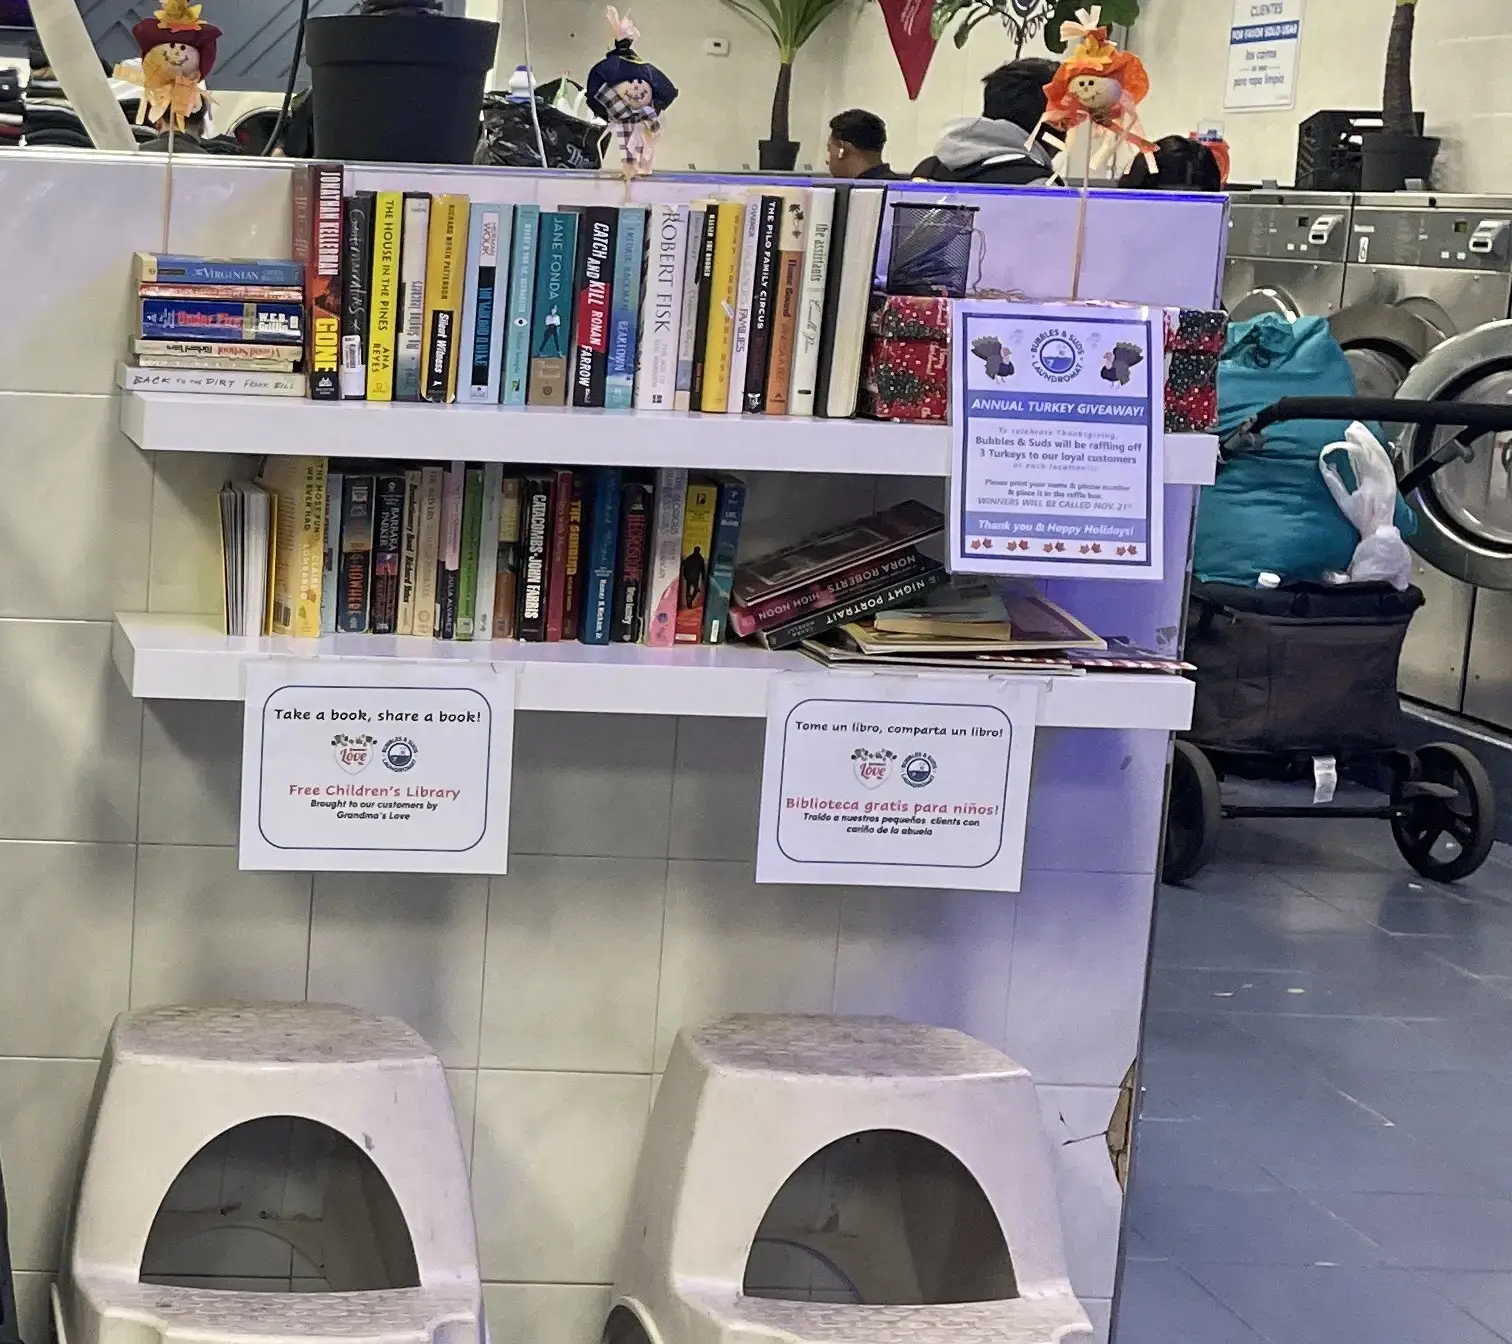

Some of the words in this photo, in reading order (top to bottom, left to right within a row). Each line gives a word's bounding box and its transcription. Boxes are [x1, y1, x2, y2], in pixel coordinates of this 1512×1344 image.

[319, 171, 341, 220] JONATHAN
[384, 200, 395, 219] THE
[767, 201, 777, 222] THE
[381, 222, 394, 262] HOUSE
[482, 222, 491, 256] WOUK
[551, 217, 564, 250] JANE
[591, 222, 610, 259] CATCH
[764, 224, 774, 249] PILO
[814, 223, 829, 238] the
[318, 221, 340, 276] KELLERMAN
[659, 212, 679, 287] ROBERT
[381, 264, 391, 276] IN
[586, 257, 602, 279] AND
[760, 250, 772, 288] FAMILY
[809, 239, 828, 283] assistants
[200, 267, 259, 280] VIRGINIAN
[548, 253, 563, 300] FONDA
[380, 278, 390, 298] THE
[587, 280, 606, 306] KILL
[377, 300, 390, 331] PINES
[654, 293, 673, 333] FISK
[757, 290, 768, 330] CIRCUS
[437, 312, 450, 340] Silent
[589, 310, 604, 346] RONAN
[735, 307, 749, 353] FAMILIES
[315, 317, 338, 373] GONE
[1030, 329, 1060, 354] BUBBLES
[1061, 329, 1067, 338] &
[1068, 333, 1086, 356] SUDS
[371, 343, 381, 373] REYES
[381, 346, 390, 370] ANA
[434, 340, 448, 374] Witness
[578, 344, 593, 387] FARROW
[133, 375, 171, 386] BACK
[205, 377, 236, 389] DIRT
[273, 381, 296, 390] BILL
[1031, 360, 1084, 384] LAUNDROMAT
[971, 398, 1025, 412] ANNUAL
[1027, 400, 1076, 414] TURKEY
[1077, 403, 1145, 417] GIVEAWAY!
[975, 436, 1015, 446] Bubbles
[1017, 437, 1026, 446] &
[1028, 437, 1052, 448] Suds
[1054, 439, 1072, 449] will
[1074, 440, 1086, 449] be
[1088, 441, 1125, 453] raffling
[1127, 443, 1142, 452] off
[979, 448, 986, 457] 3
[989, 449, 1027, 461] Turkeys
[1028, 451, 1039, 460] to
[1041, 452, 1059, 461] our
[1061, 452, 1085, 464] loyal
[1087, 455, 1137, 465] customers
[305, 484, 313, 508] EVER
[314, 484, 323, 512] MOST
[977, 497, 1020, 507] WINNERS
[1022, 499, 1043, 507] WILL
[1058, 500, 1092, 509] CALLED
[303, 510, 312, 531] HAD
[313, 514, 322, 533] FUN
[379, 511, 390, 547] PARKER
[388, 507, 401, 551] BARBARA
[530, 494, 547, 554] CATACOMBS
[978, 519, 1011, 531] Thank
[1012, 522, 1033, 532] you
[1035, 523, 1045, 532] &
[1047, 523, 1082, 536] Happy
[1083, 524, 1135, 537] Holidays!
[526, 556, 543, 583] JOHN
[881, 554, 916, 574] NORA
[346, 563, 365, 616] NOWHERE
[446, 573, 456, 597] JULIA
[826, 568, 880, 593] ROBERTS
[887, 581, 926, 602] NIGHT
[524, 584, 541, 619] FARRIS
[758, 601, 792, 621] NOON
[792, 591, 821, 607] HIGH
[824, 596, 885, 625] PORTRAIT
[444, 598, 454, 634] ALVAREZ
[274, 708, 311, 721] Take
[315, 712, 325, 721] a
[330, 709, 372, 723] book,
[377, 710, 419, 723] share
[423, 712, 434, 723] a
[439, 710, 482, 723] book!
[795, 721, 829, 732] Tome
[832, 724, 848, 732] un
[852, 721, 884, 734] libro,
[887, 724, 947, 737] comparta
[951, 727, 967, 737] un
[971, 727, 1004, 738] libro!
[339, 748, 368, 766] Love
[859, 762, 886, 780] Love
[289, 784, 321, 797] Free
[325, 784, 402, 798] Children's
[405, 786, 461, 801] Library
[310, 799, 347, 809] Brought
[348, 800, 358, 808] to
[377, 801, 424, 810] customers
[426, 801, 439, 812] by
[336, 810, 387, 820] Grandma's
[389, 811, 411, 820] Love
[785, 797, 859, 811] Biblioteca
[864, 799, 909, 814] gratis
[913, 802, 948, 816] para
[953, 802, 1000, 816] niños!
[833, 814, 840, 822] a
[841, 814, 880, 824] nuestros
[881, 815, 926, 827] pequeños
[930, 816, 961, 826] clients
[963, 819, 980, 827] con
[846, 824, 875, 834] cariño
[876, 825, 888, 834] de
[890, 825, 899, 834] la
[901, 826, 934, 836] abuela
